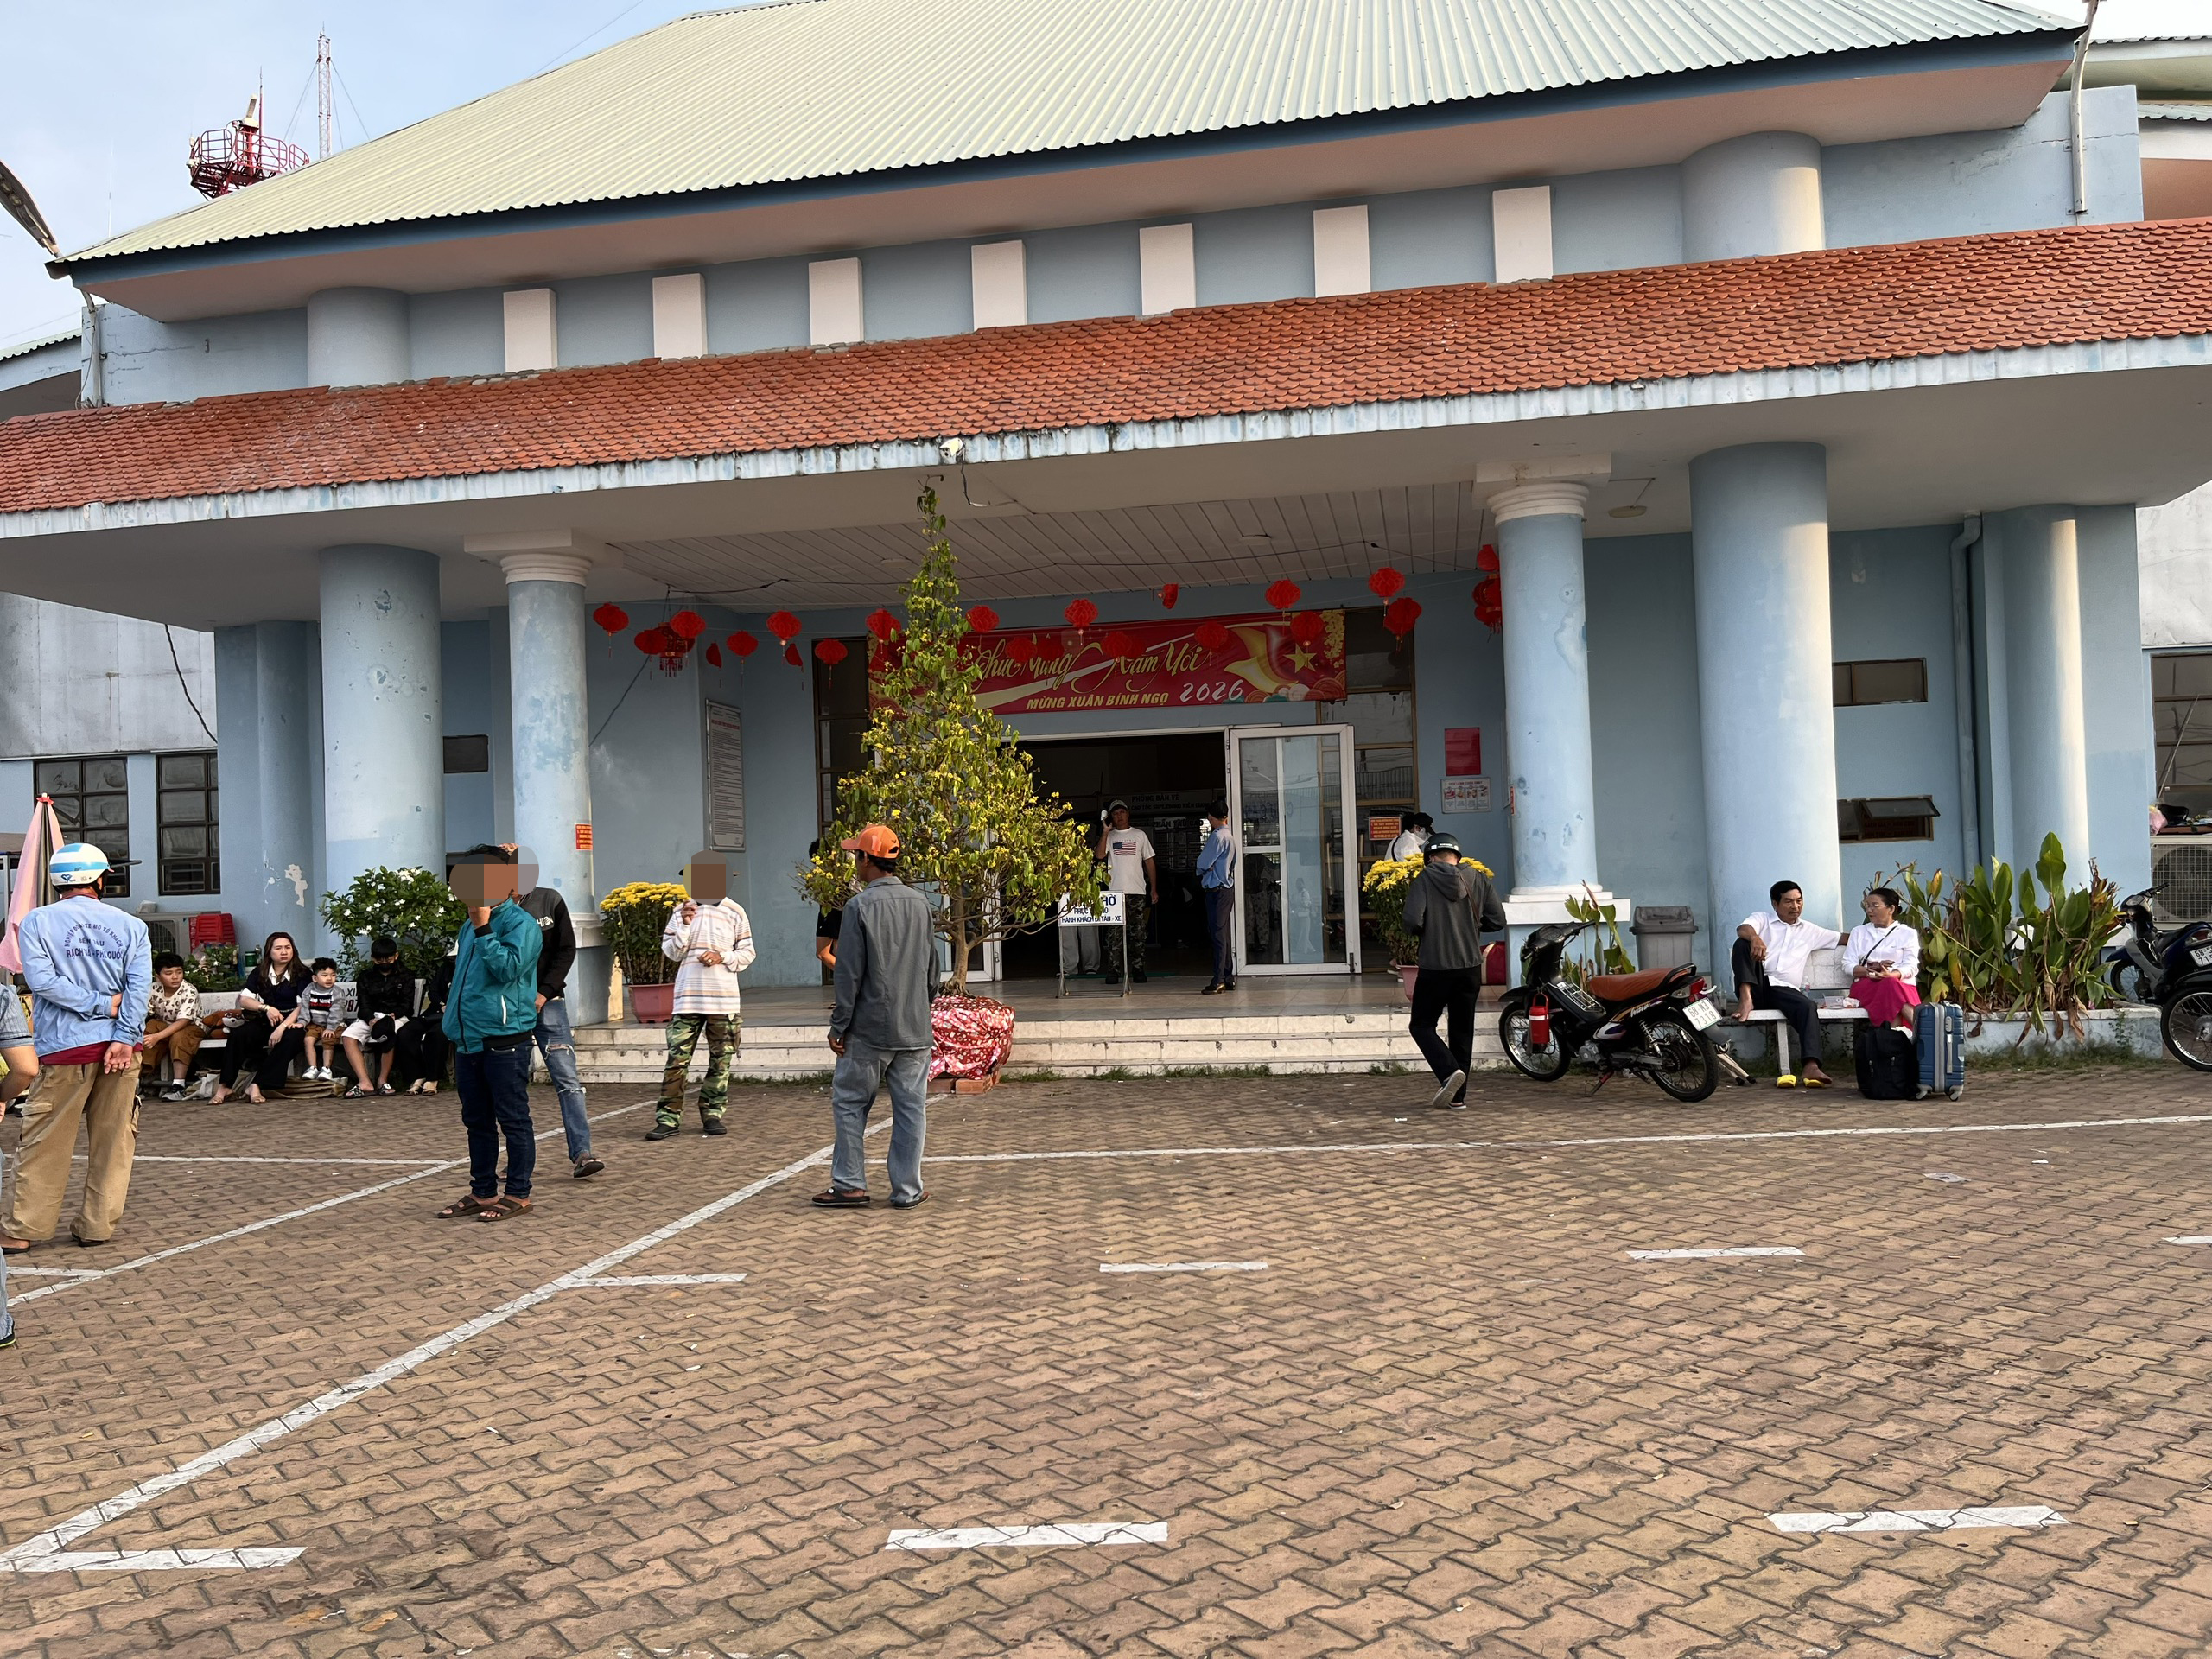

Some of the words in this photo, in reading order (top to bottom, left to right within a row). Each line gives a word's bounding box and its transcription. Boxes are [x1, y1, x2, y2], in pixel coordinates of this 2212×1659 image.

[1179, 679, 1244, 702] 2026
[1027, 696, 1065, 709] MỪNG
[1067, 694, 1104, 708] XUÂN
[1106, 692, 1140, 706] BÍNH
[1141, 693, 1169, 706] NGỌ
[1694, 1010, 1717, 1027] 7318
